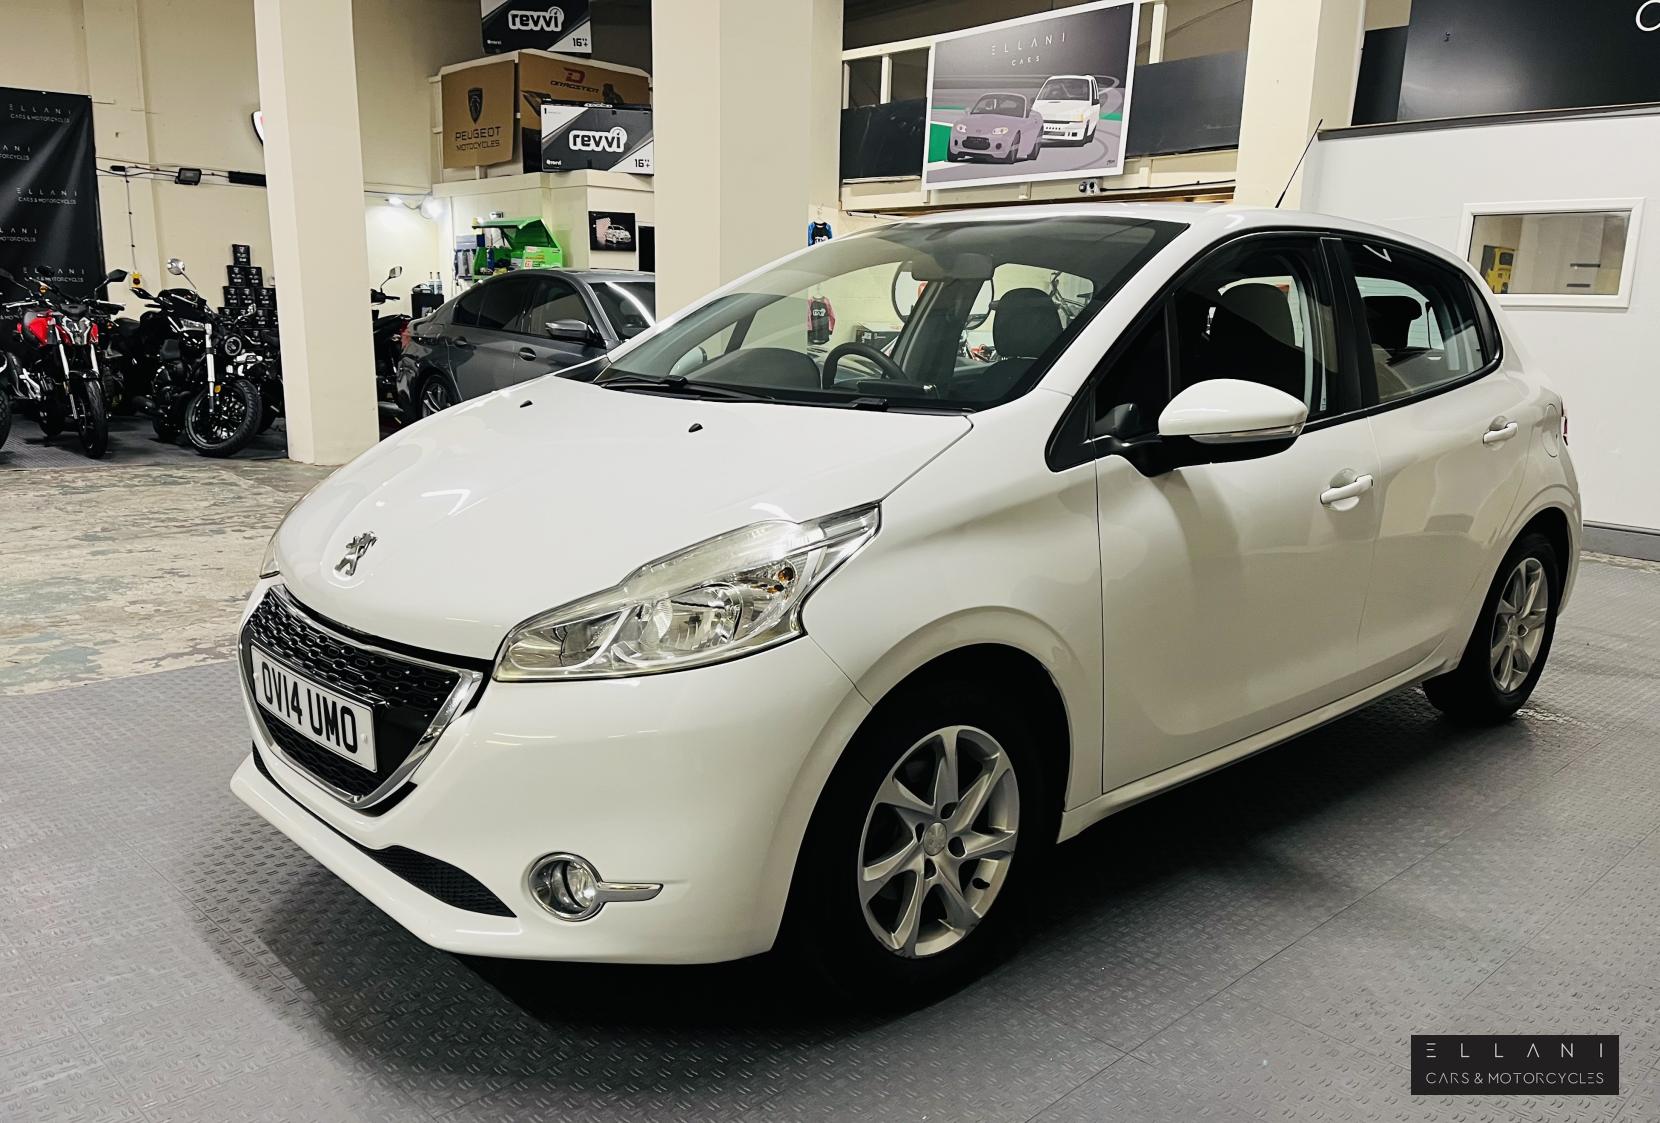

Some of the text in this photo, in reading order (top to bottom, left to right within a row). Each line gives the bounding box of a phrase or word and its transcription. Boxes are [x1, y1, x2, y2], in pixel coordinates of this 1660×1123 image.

[510, 9, 561, 29] revvi
[992, 32, 1065, 55] ELLANI
[1011, 55, 1040, 66] CARS
[455, 126, 501, 141] PEUGEOT
[571, 130, 623, 150] revvi
[261, 661, 358, 754] OV14 UMO
